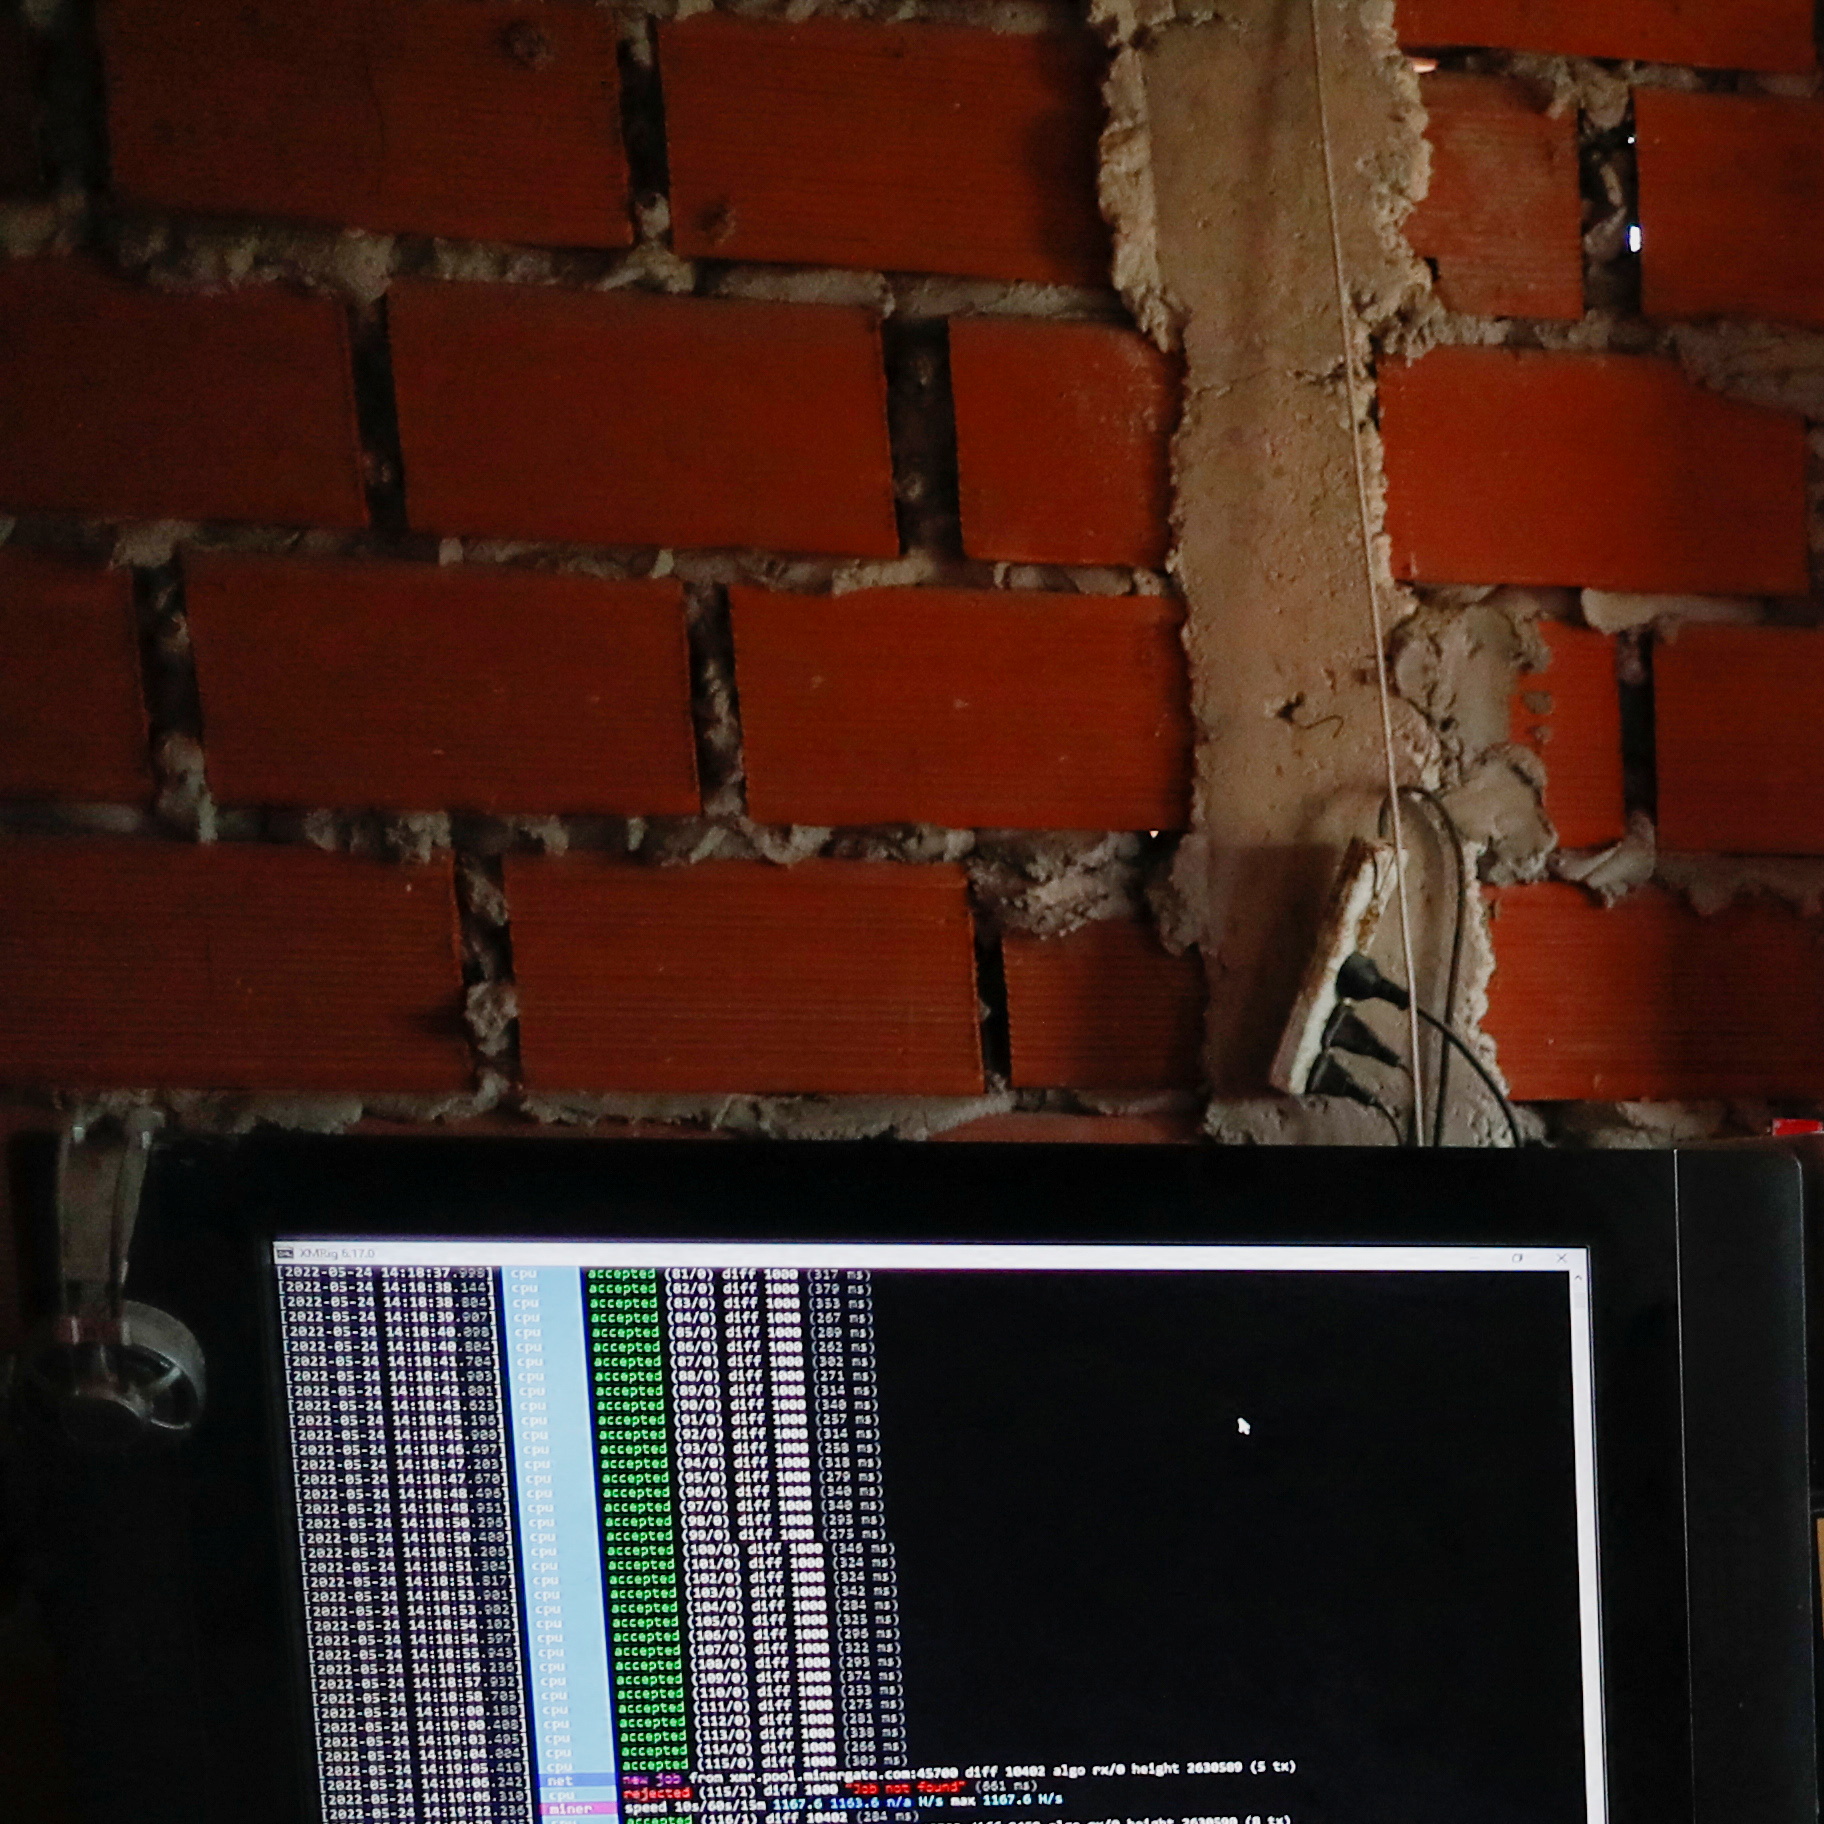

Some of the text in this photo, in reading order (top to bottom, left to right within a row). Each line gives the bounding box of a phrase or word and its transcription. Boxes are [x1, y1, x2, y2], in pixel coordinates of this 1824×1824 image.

[279, 1281, 373, 1294] [2022-05-24
[512, 1284, 538, 1295] cpu
[589, 1283, 656, 1296] accepted
[723, 1283, 756, 1295] diff
[766, 1283, 798, 1294] 1000
[848, 1284, 871, 1296] ms)
[286, 1370, 380, 1384] [2022-05-24
[518, 1373, 545, 1383] cpu
[595, 1370, 662, 1385] accepted
[729, 1370, 762, 1382] diff
[771, 1370, 804, 1382] 1000
[853, 1371, 876, 1382] ms)
[293, 1459, 387, 1472] [2022-05-24
[525, 1460, 551, 1471] cpu
[602, 1457, 668, 1472] accepted
[734, 1457, 768, 1469] diff
[776, 1457, 809, 1469] 1000
[858, 1458, 881, 1469] ms)
[302, 1562, 395, 1575] [2022-05-24
[532, 1562, 558, 1573] cpu
[608, 1558, 674, 1571] accepted
[749, 1557, 782, 1570] diff
[790, 1557, 824, 1569] 1000
[872, 1557, 896, 1569] ms)
[310, 1663, 403, 1677] [2022-05-24
[539, 1663, 566, 1674] cpu
[616, 1658, 681, 1672] accepted
[756, 1657, 788, 1670] diff
[797, 1657, 830, 1669] 1000
[878, 1656, 901, 1668] ms)
[320, 1778, 412, 1793] [2022-05-24
[548, 1775, 573, 1785] net
[623, 1776, 649, 1784] new
[656, 1773, 682, 1786] job
[689, 1771, 722, 1783] from
[965, 1766, 998, 1778] diff
[1053, 1764, 1085, 1778] algo
[1132, 1762, 1179, 1776] height
[321, 1793, 414, 1808] [2022-05-24
[549, 1791, 575, 1802] cpu
[624, 1786, 690, 1801] rejected
[764, 1784, 796, 1796] diff
[805, 1784, 838, 1795] 1000
[1014, 1780, 1037, 1792] ms)
[322, 1807, 415, 1822] [2022-05-24
[550, 1803, 592, 1814] miner
[625, 1800, 667, 1816] speed
[951, 1797, 975, 1806] max
[766, 1812, 798, 1824] diff
[896, 1810, 918, 1822] ms)
